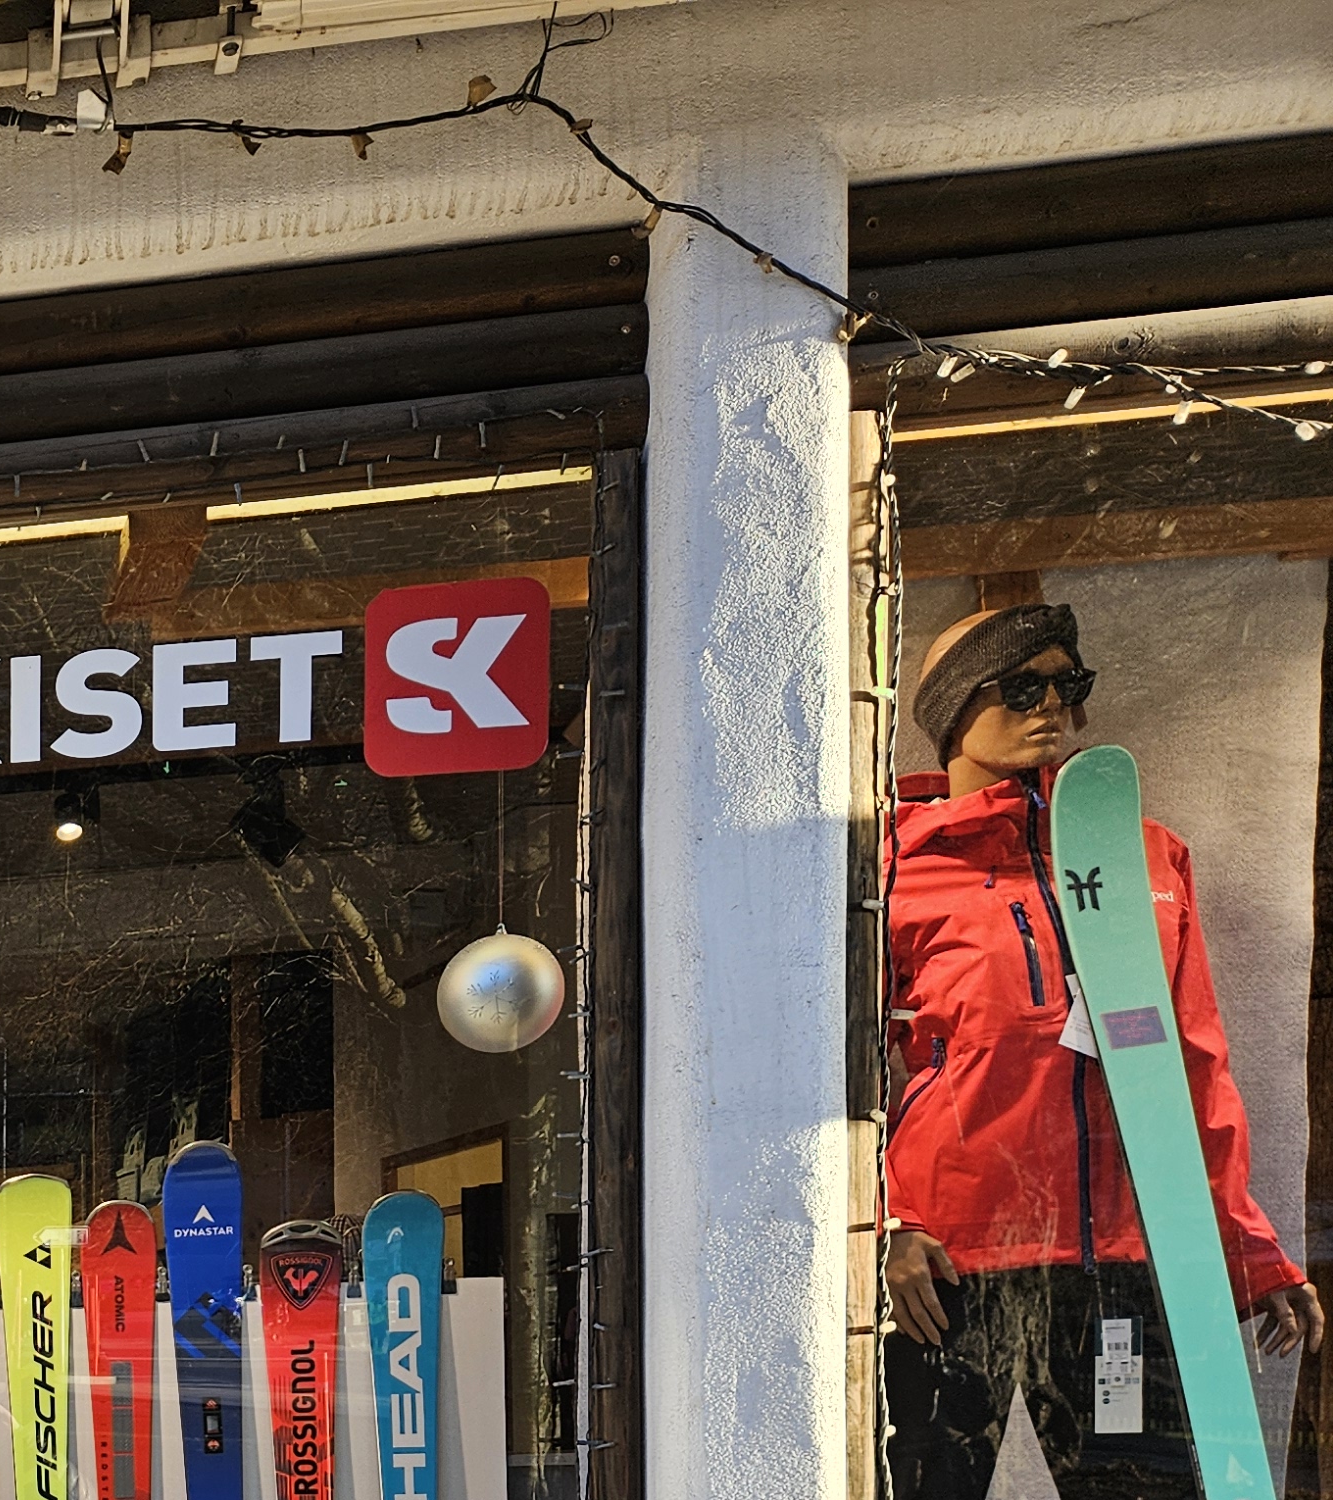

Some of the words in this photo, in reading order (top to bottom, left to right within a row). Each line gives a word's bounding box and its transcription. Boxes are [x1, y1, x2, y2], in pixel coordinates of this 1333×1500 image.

[386, 613, 530, 734] SK
[174, 1225, 234, 1238] DYNASTAR
[279, 1256, 323, 1267] ROSSIGNOL
[114, 1275, 125, 1333] ATOMIC
[290, 1340, 319, 1495] ROSSIGNOL
